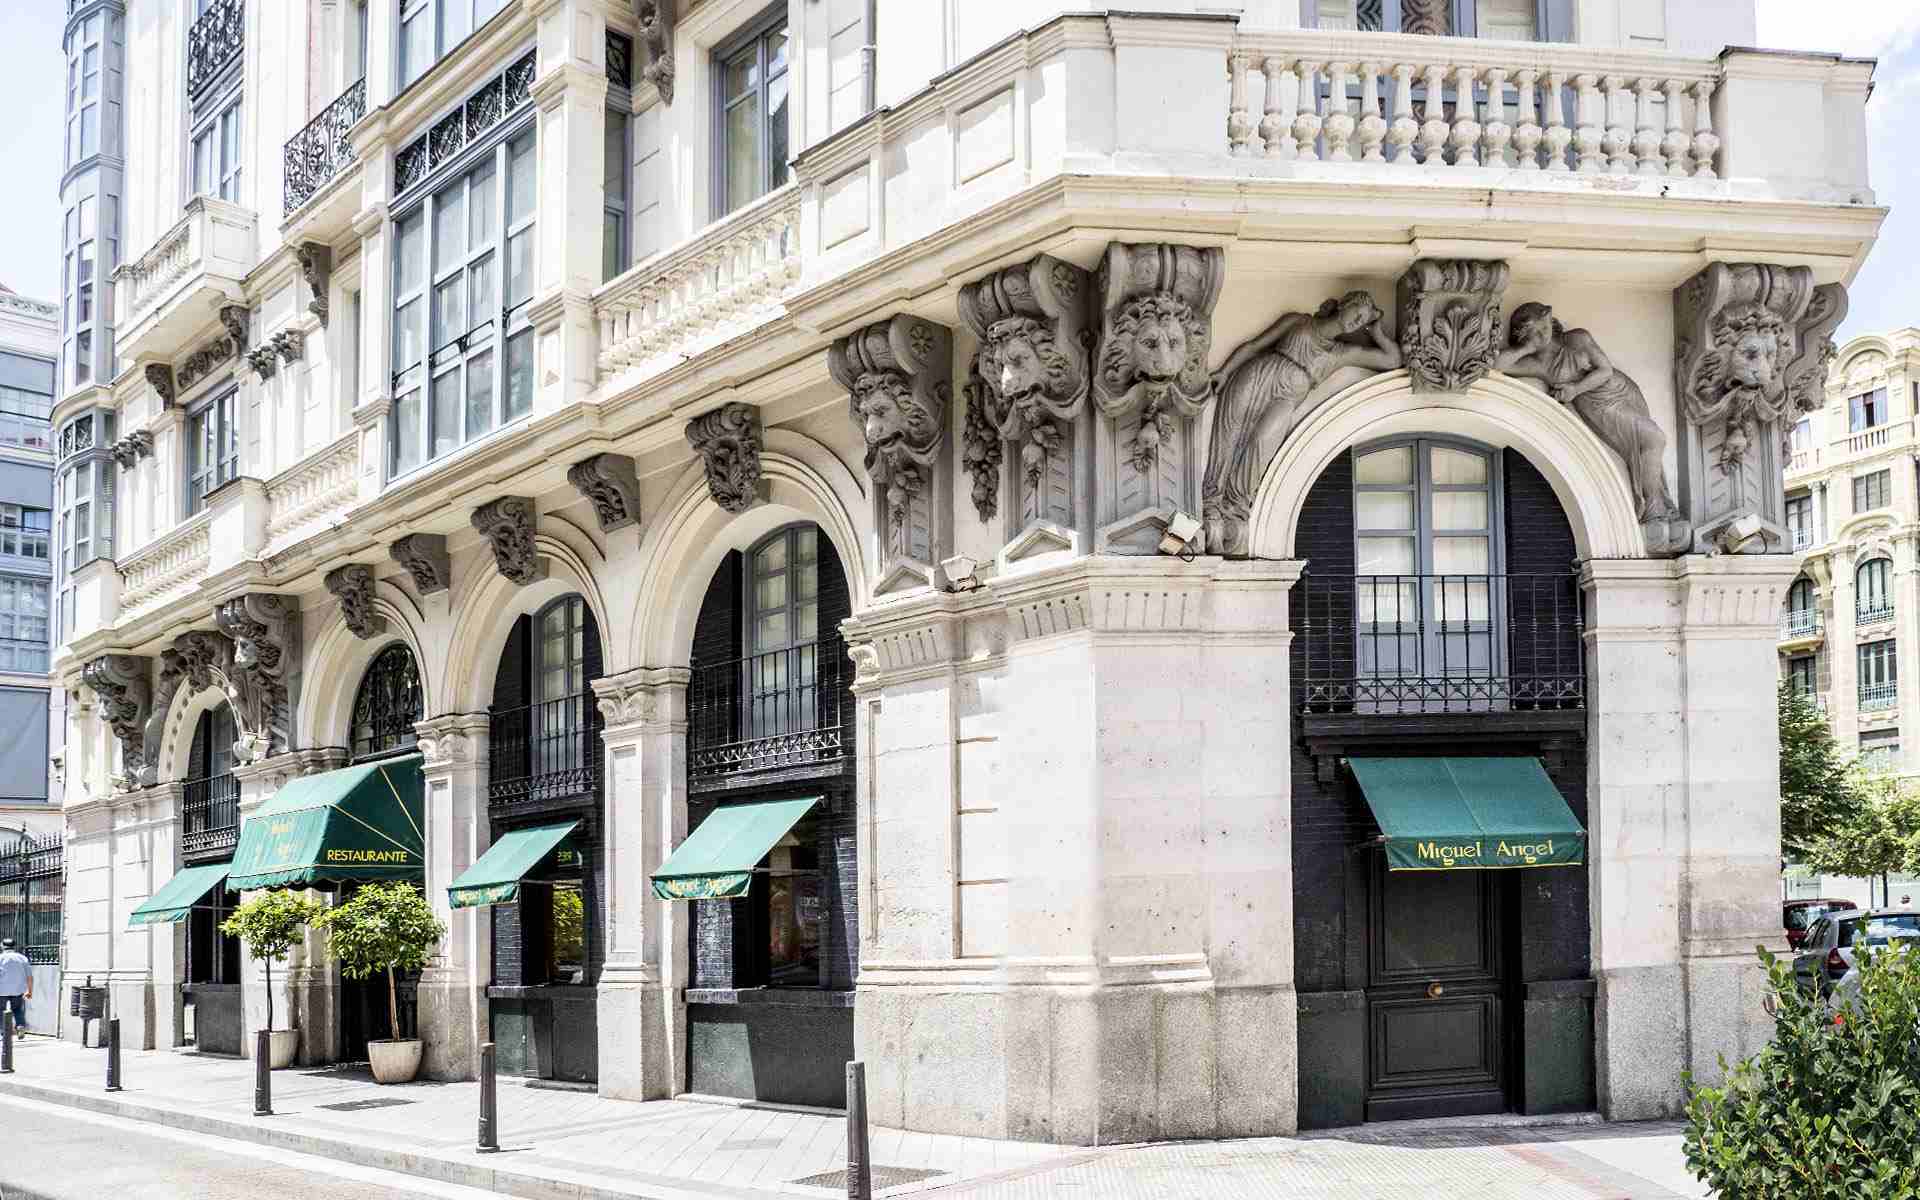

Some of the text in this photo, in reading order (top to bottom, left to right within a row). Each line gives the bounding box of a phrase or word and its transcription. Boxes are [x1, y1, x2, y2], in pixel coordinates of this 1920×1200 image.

[327, 849, 408, 862] RESTAURANTE
[1417, 840, 1554, 866] Miguel Angel
